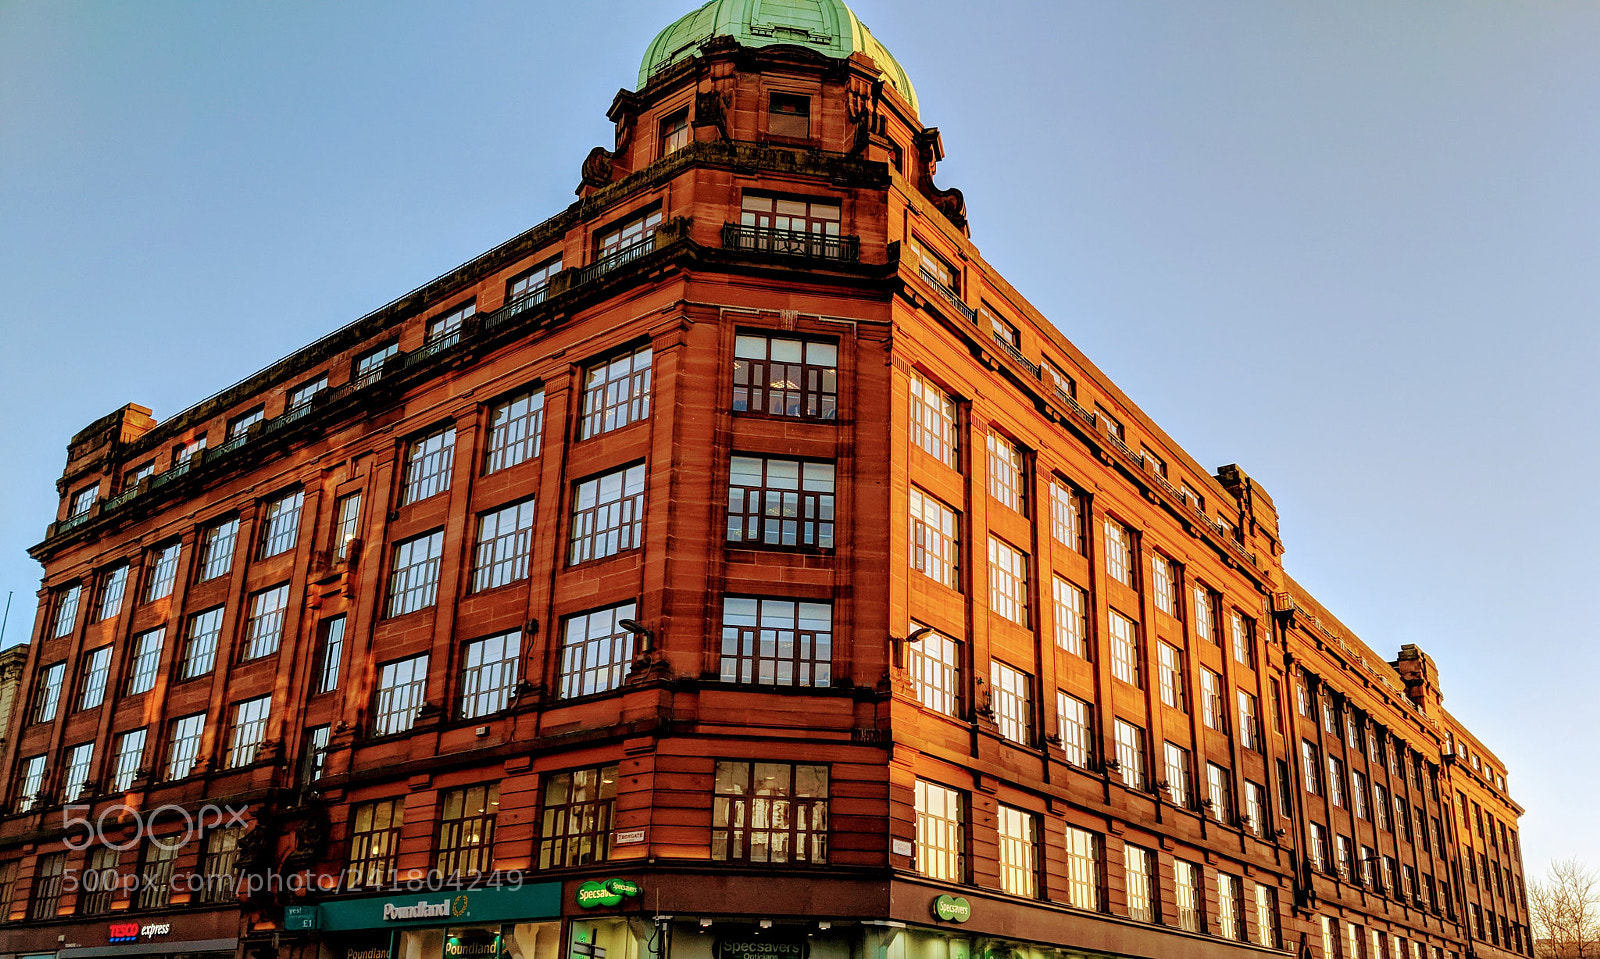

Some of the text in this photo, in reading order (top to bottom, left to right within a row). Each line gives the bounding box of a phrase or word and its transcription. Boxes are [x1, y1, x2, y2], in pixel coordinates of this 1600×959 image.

[612, 882, 638, 893] Specsavers
[579, 888, 619, 901] Specsav
[383, 899, 450, 920] Poundland
[940, 901, 968, 915] Specsavers
[302, 919, 312, 928] £1
[110, 923, 170, 938] TESCO express
[445, 940, 497, 955] Poundland
[723, 941, 799, 953] Specsavers
